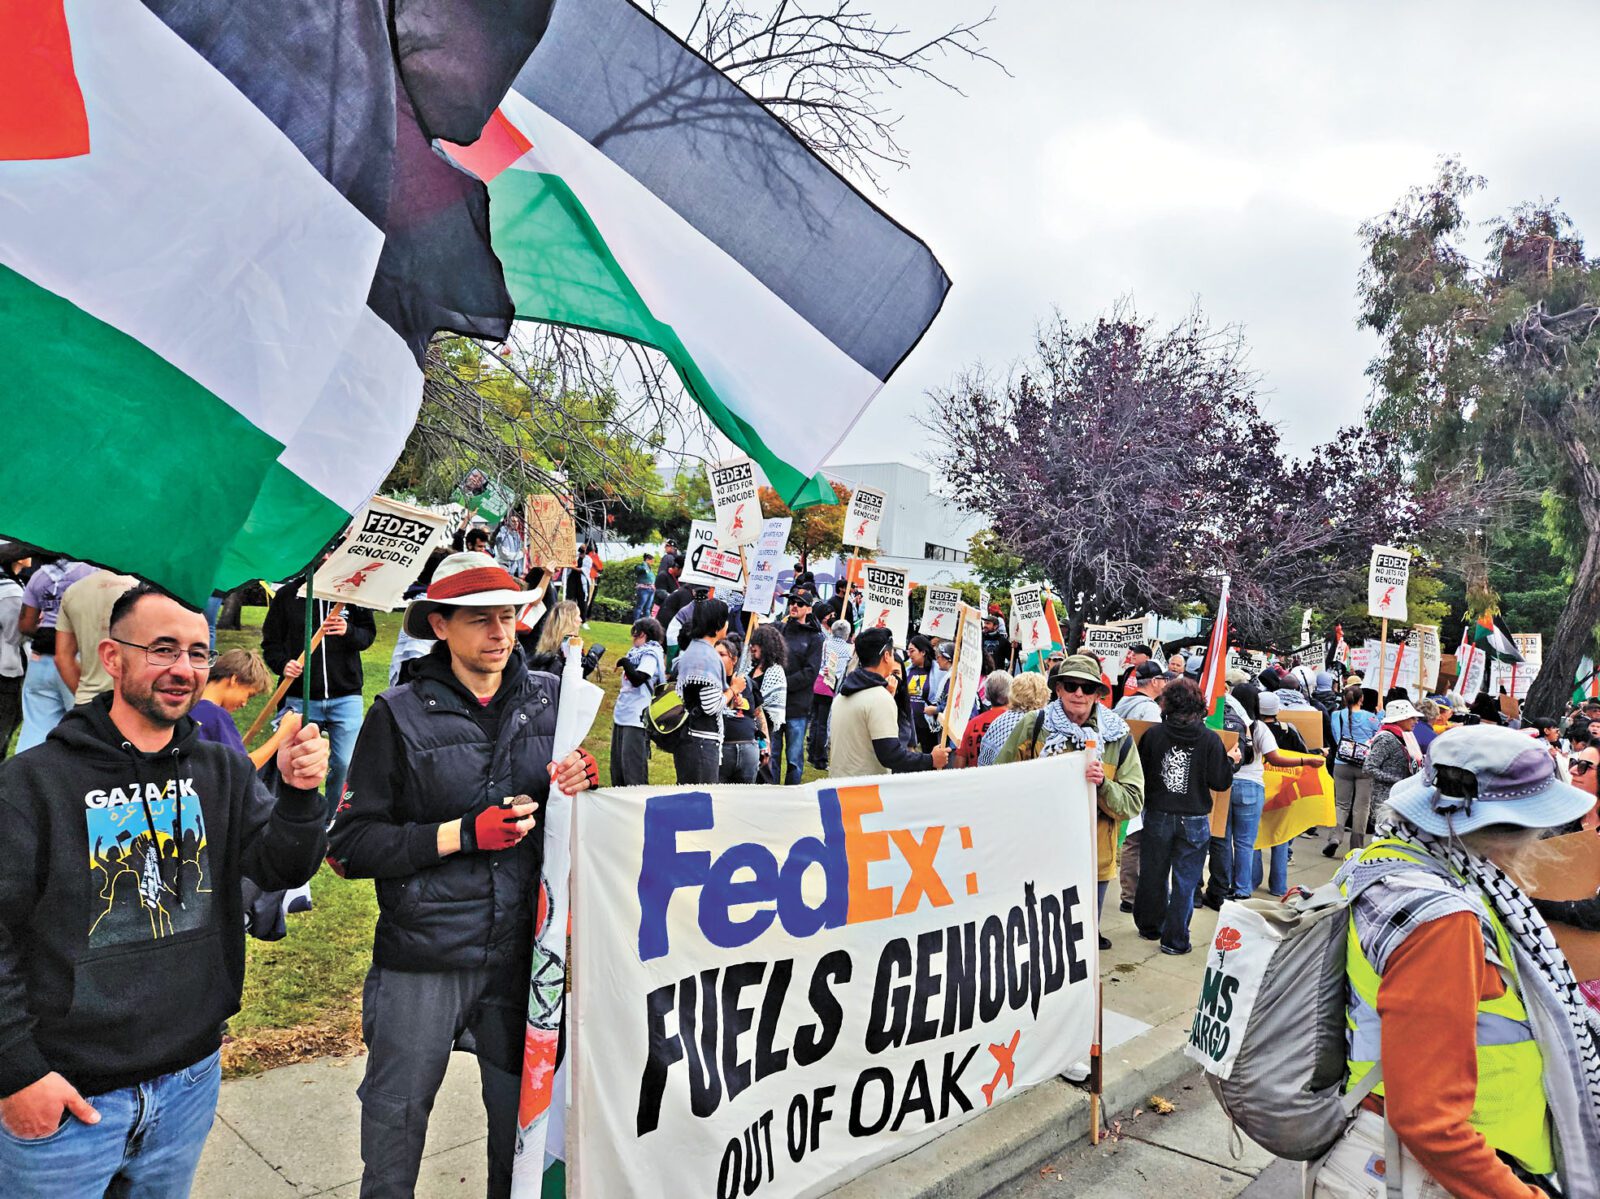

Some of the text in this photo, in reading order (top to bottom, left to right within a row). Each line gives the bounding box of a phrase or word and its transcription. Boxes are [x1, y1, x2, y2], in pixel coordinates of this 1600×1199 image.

[713, 465, 751, 486] FEDEX:
[727, 483, 740, 493] JETS
[741, 479, 754, 488] FOR
[718, 489, 755, 507] GENOCIDE!
[857, 491, 882, 506] FEDEX:
[853, 508, 880, 521] GENOCIDE!
[365, 513, 430, 543] FEDEX:
[695, 529, 713, 540] NO
[356, 533, 421, 555] NO JETS FOR
[347, 545, 413, 568] GENOCIDE!
[869, 569, 905, 588] FEDEX:
[877, 585, 890, 594] JETS
[891, 588, 904, 596] FOR
[930, 591, 958, 601] FEDEX:
[1015, 591, 1038, 605] FEDEX:
[868, 592, 904, 608] GENOCIDE!
[929, 605, 956, 613] GENOCIDE!
[1090, 631, 1121, 642] FEDEX:
[85, 778, 198, 809] GAZA 5K
[637, 784, 979, 962] FedEx:
[1198, 967, 1240, 1023] MS
[636, 880, 1089, 1138] FUELS GENOCIDE
[1189, 1012, 1230, 1062] ARGO
[716, 1043, 980, 1199] OUT OF OAK
